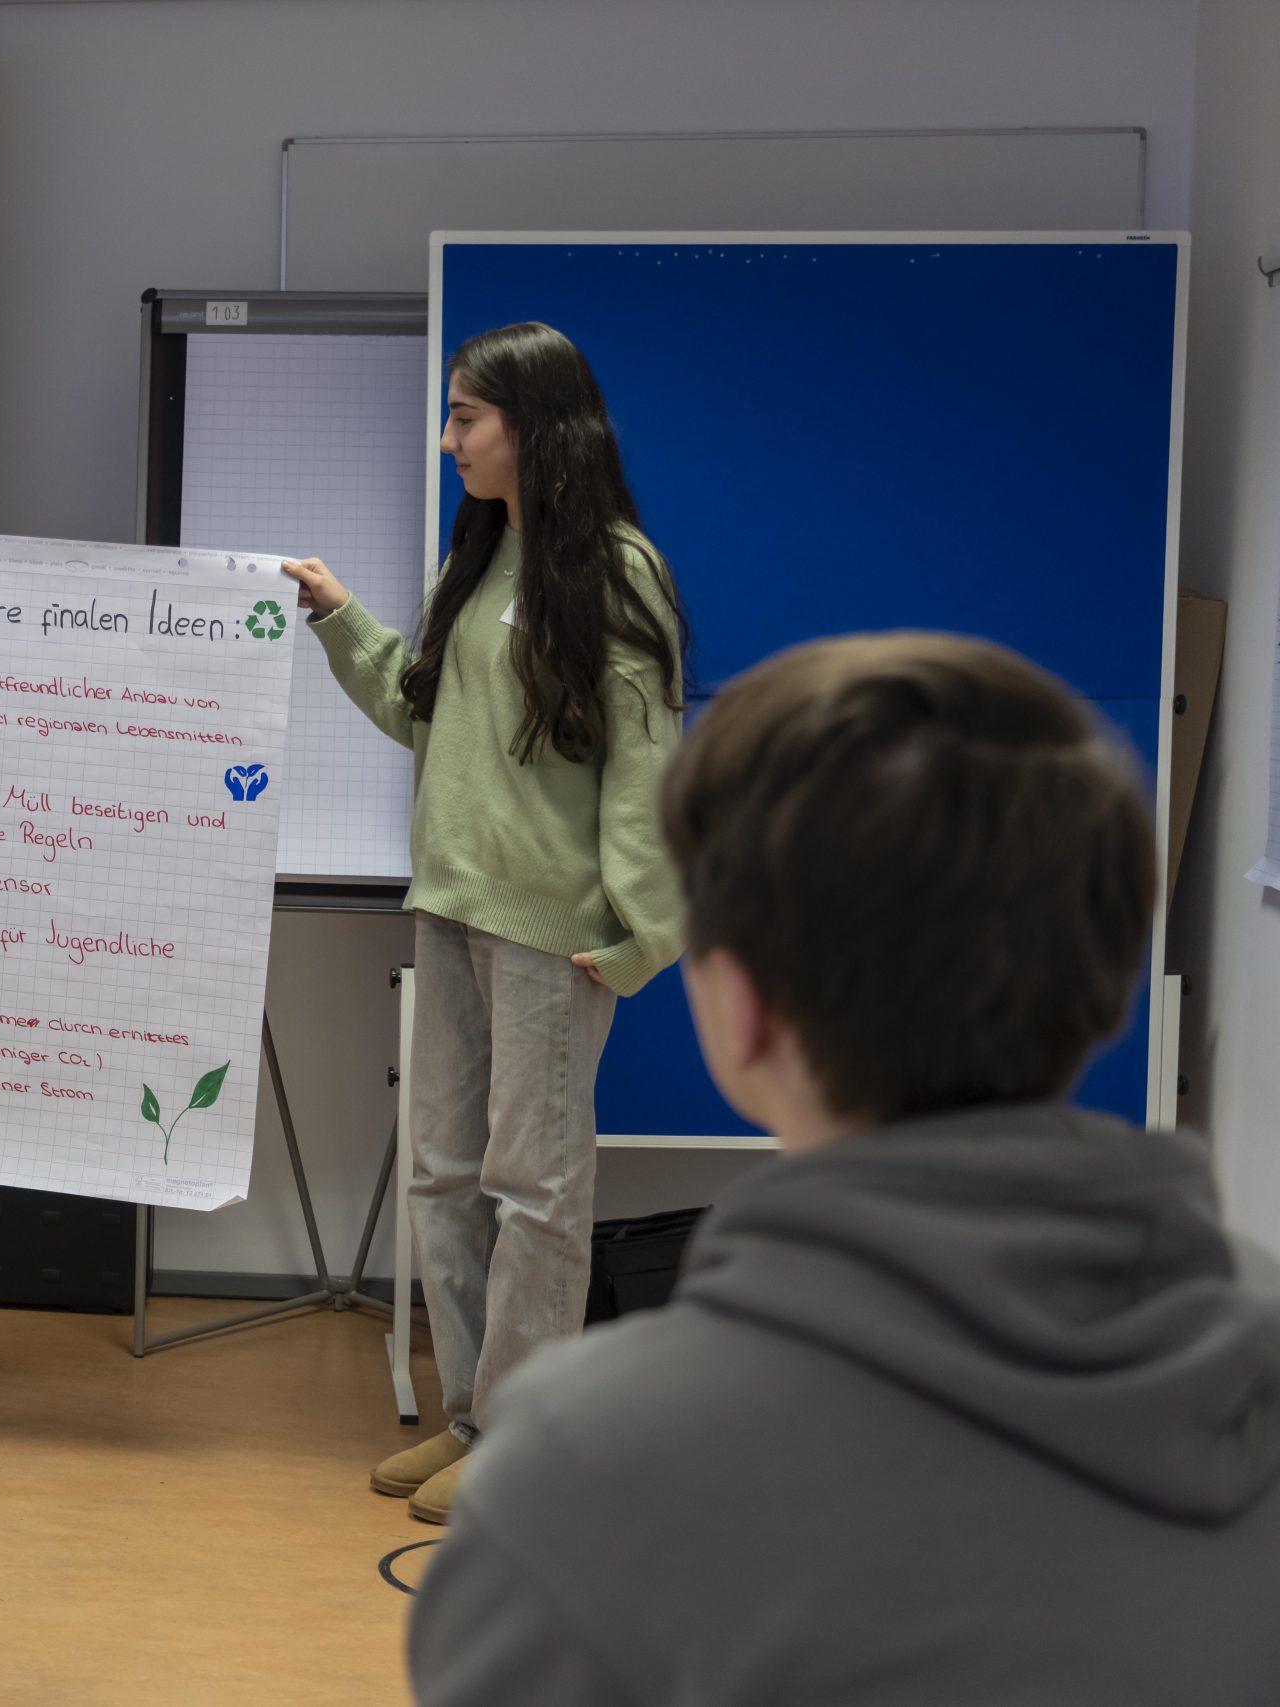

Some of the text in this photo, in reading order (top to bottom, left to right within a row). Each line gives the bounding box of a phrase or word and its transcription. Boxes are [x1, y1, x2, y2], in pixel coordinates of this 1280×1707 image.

[41, 598, 130, 636] finalen
[120, 686, 178, 706] Anbau
[183, 697, 221, 711] von
[16, 714, 108, 737] regionalen
[116, 720, 243, 747] Lebensmitteln
[3, 784, 52, 813] Müll
[71, 796, 169, 833] beseitigen
[187, 811, 226, 830] und
[20, 820, 94, 863] Regeln
[0, 926, 27, 953] für
[45, 918, 176, 965] Jugendliche
[40, 1081, 94, 1101] Strom
